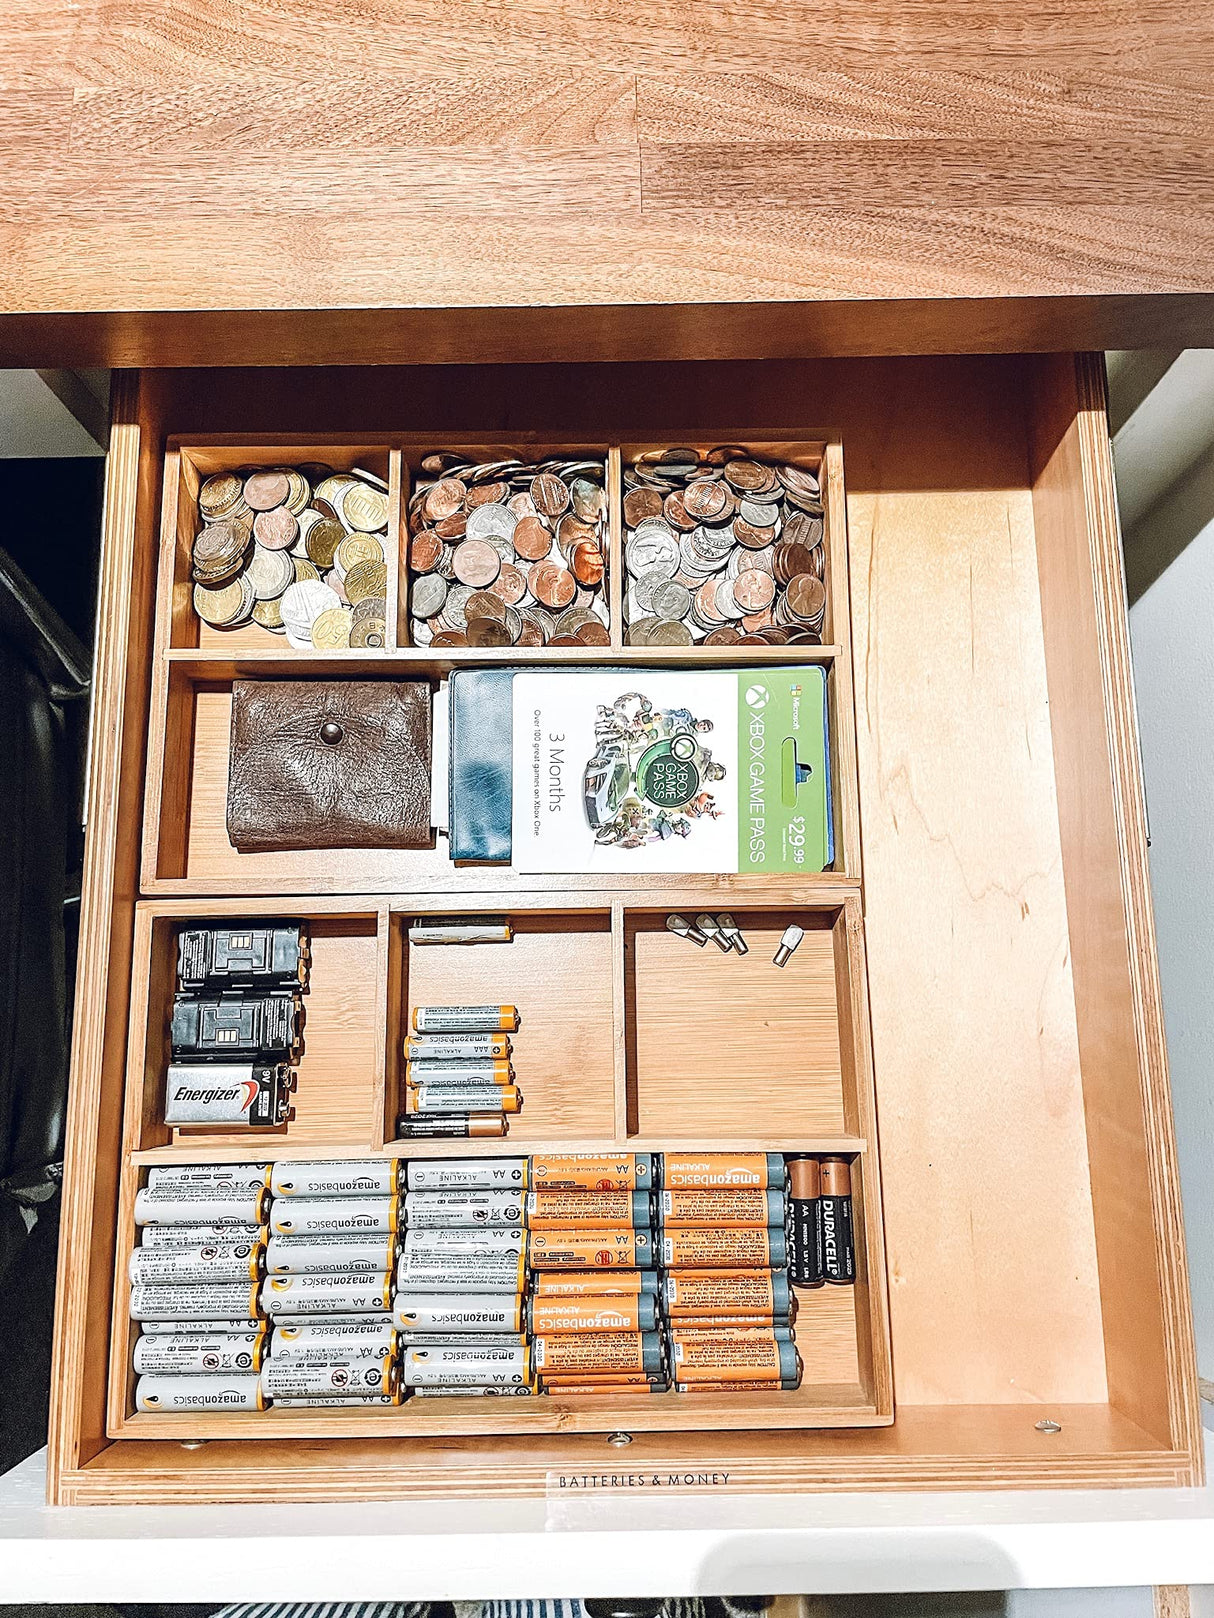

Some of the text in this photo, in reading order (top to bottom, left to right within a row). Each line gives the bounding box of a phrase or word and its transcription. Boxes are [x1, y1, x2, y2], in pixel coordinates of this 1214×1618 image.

[533, 709, 541, 727] Over
[791, 697, 801, 731] Microsoft
[533, 729, 541, 742] 100
[532, 743, 541, 762] great
[532, 763, 541, 787] games
[549, 733, 566, 812] 3 Months
[653, 763, 665, 799] PASS
[665, 763, 677, 799] GAME
[676, 763, 688, 799] XBOX
[749, 712, 766, 863] XBOX GAME PASS
[533, 789, 541, 799] on
[533, 800, 541, 818] Xbox
[788, 815, 806, 864] $29.99
[430, 1035, 488, 1045] amazonbasics
[262, 1069, 271, 1084] 9V
[173, 1086, 241, 1105] Energizer
[615, 1164, 629, 1174] AA
[670, 1163, 711, 1171] ALKALINE
[492, 1169, 506, 1179] AA
[670, 1173, 761, 1187] amazonbasics
[308, 1182, 380, 1193] amazonbasics
[802, 1204, 809, 1217] AA
[306, 1218, 379, 1231] amazonbasics
[492, 1230, 505, 1238] AA
[615, 1235, 629, 1244] AA
[822, 1199, 838, 1272] DURACELL
[304, 1262, 377, 1272] amazonbasics
[302, 1276, 375, 1289] amazonbasics
[545, 1285, 585, 1293] ALKALINE
[353, 1298, 366, 1306] AA
[540, 1306, 580, 1315] ALKALINE
[432, 1312, 505, 1325] amazonbasics
[540, 1316, 631, 1331] amazonbasics
[311, 1325, 383, 1338] amazonbasics
[360, 1347, 373, 1357] AA
[442, 1351, 515, 1363] amazonbasics
[492, 1374, 506, 1382] AA
[173, 1394, 247, 1407] amazonbasics
[559, 1472, 730, 1488] BATTERIES & MONEY
